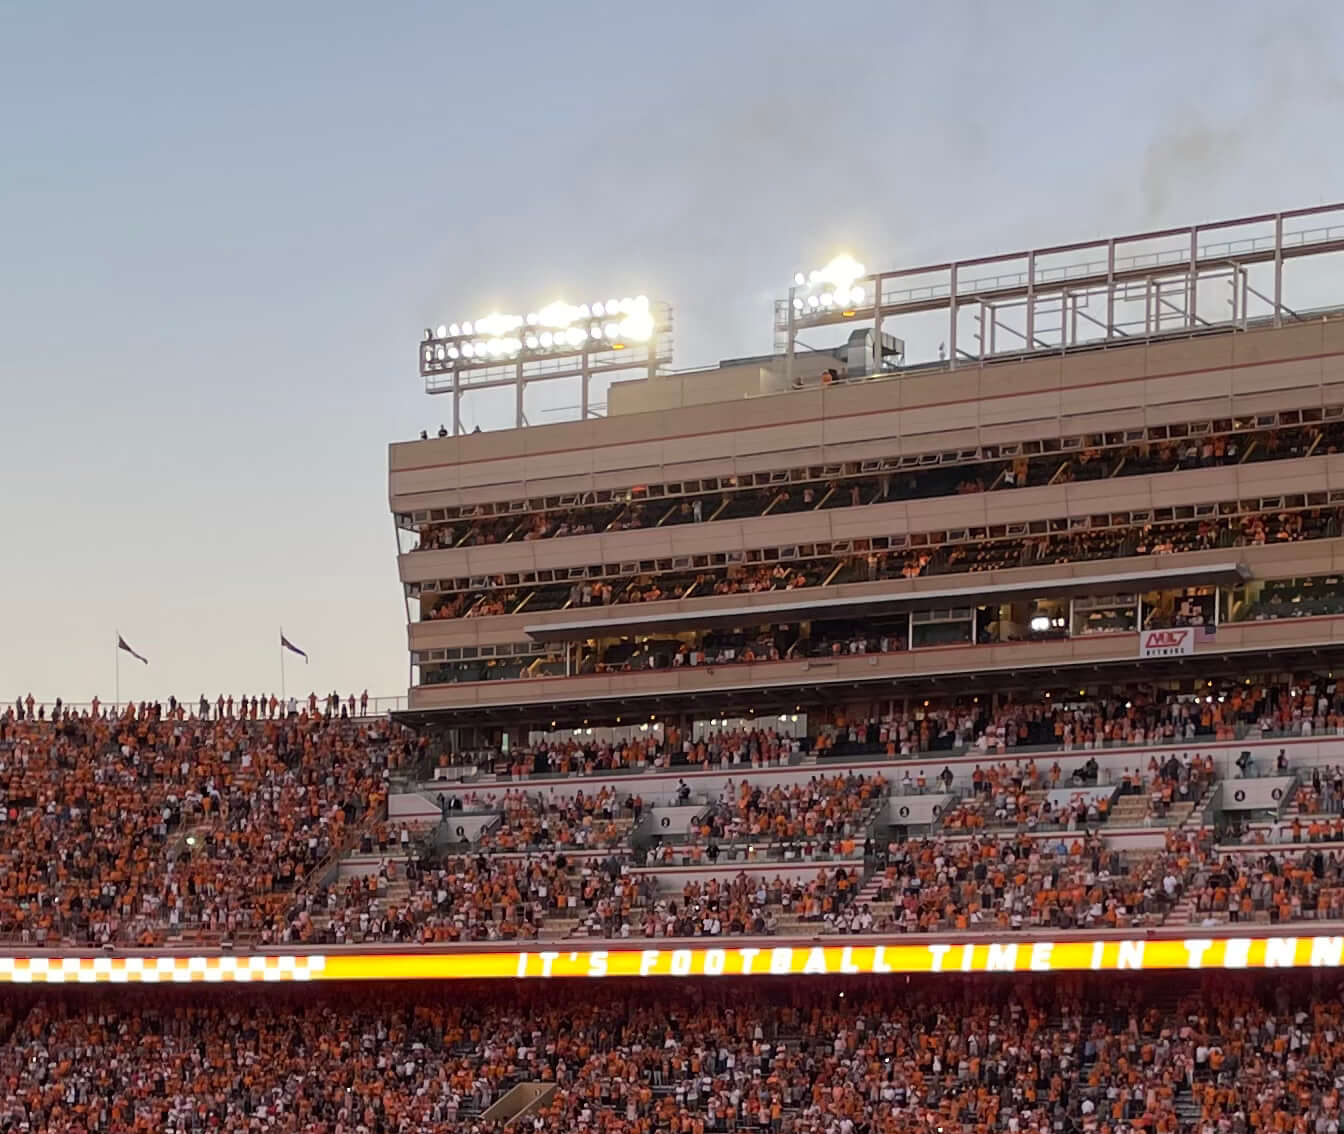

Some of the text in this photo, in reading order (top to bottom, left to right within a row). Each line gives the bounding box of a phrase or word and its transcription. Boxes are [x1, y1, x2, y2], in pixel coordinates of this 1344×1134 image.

[516, 951, 608, 977] IT'S
[640, 946, 891, 975] FOOTBALL
[928, 942, 1054, 971] TIME
[1090, 940, 1145, 970] IN
